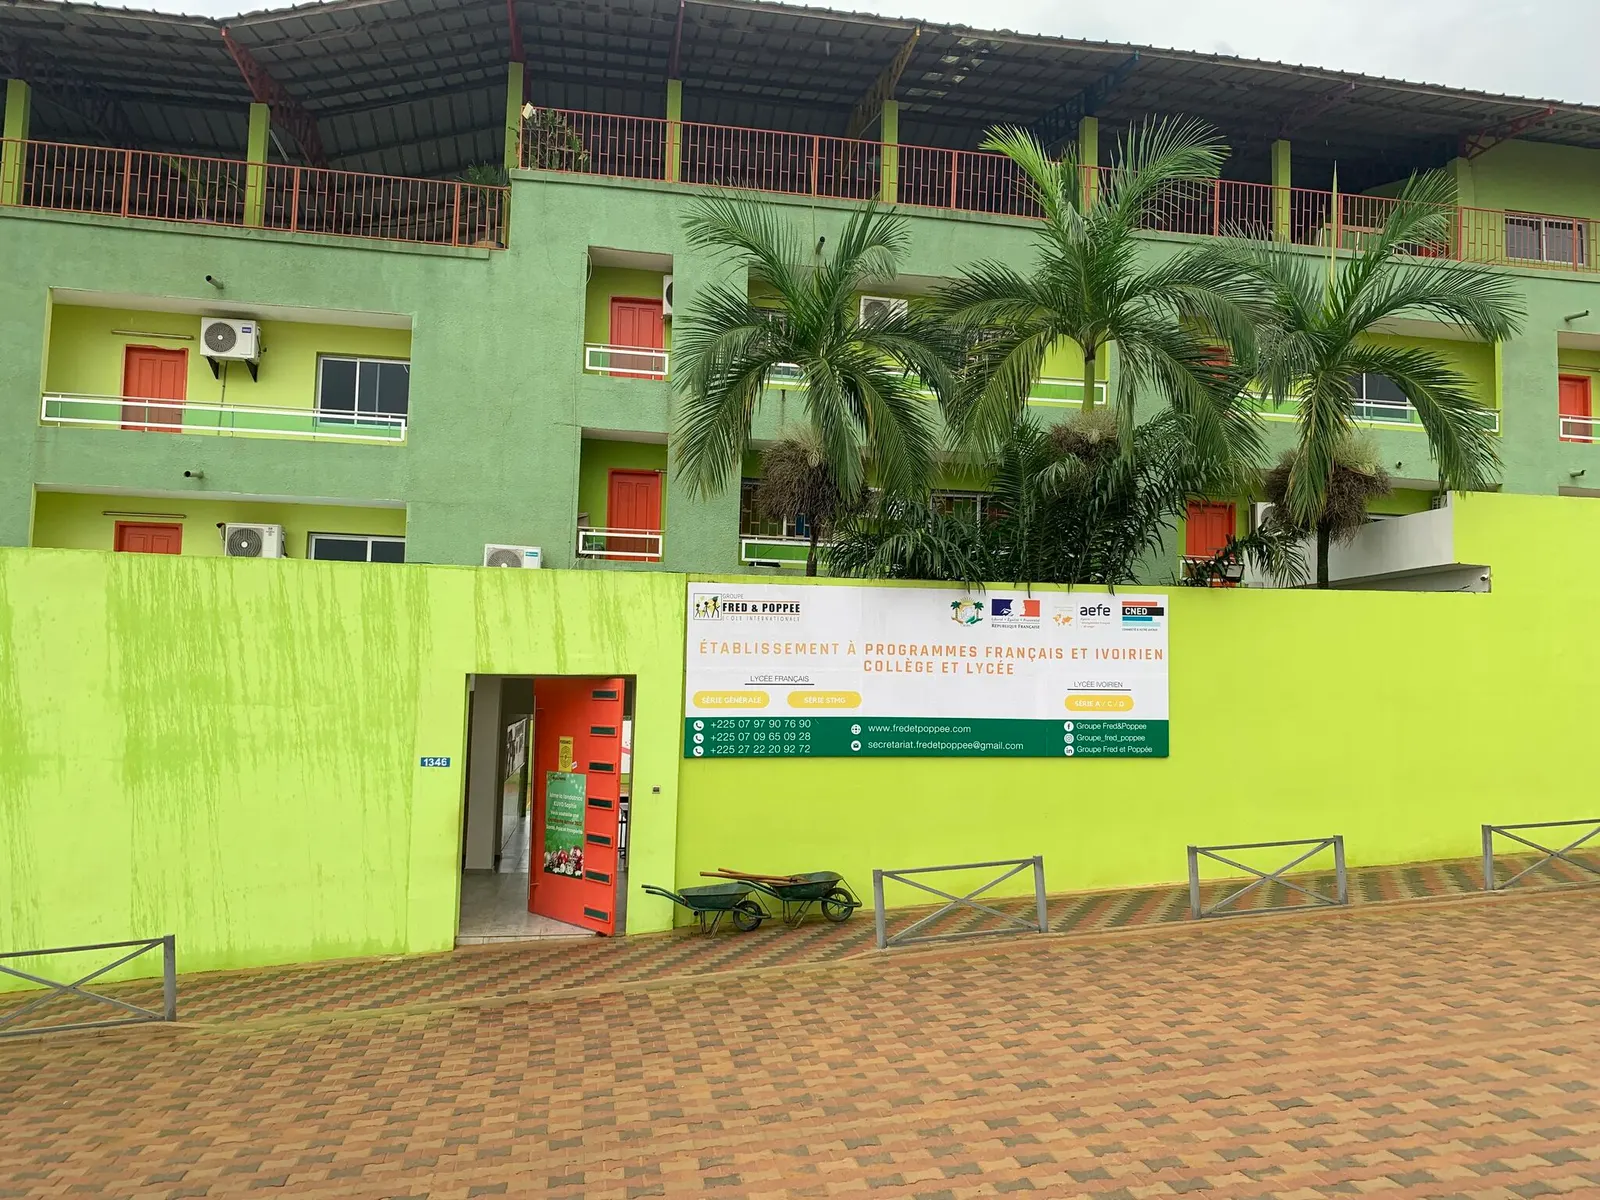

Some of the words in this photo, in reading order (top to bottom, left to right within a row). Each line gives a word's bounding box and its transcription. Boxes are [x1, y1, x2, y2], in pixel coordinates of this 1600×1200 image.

[722, 602, 748, 612] FRED
[751, 603, 758, 613] &
[762, 603, 800, 613] POPPEE
[1080, 603, 1111, 617] aefe
[1125, 608, 1148, 616] CNED
[700, 638, 840, 655] ÉTABLISSEMENT
[847, 640, 857, 655] À
[865, 643, 977, 657] PROGRAMMES
[986, 646, 1064, 662] FRANÇAIS
[1072, 648, 1088, 660] ET
[1096, 648, 1163, 660] IVOIRIEN
[864, 658, 934, 673] COLLÈGE
[942, 661, 958, 673] ET
[966, 660, 1014, 675] LYCÉE
[750, 674, 773, 682] LYCÉE
[774, 675, 810, 683] FRANÇAIS
[1074, 680, 1095, 688] LYCÉE
[702, 695, 722, 704] SÉRIE
[724, 695, 762, 704] GÉNÉRALE
[804, 696, 824, 704] SÉRIE
[1074, 699, 1093, 707] SÉRIE
[710, 720, 736, 728] +225
[738, 720, 750, 728] 07
[753, 720, 766, 728] 97
[768, 720, 781, 728] 90
[784, 720, 796, 728] 76
[798, 720, 812, 728] 90
[1076, 722, 1102, 730] Groupe
[1102, 722, 1146, 730] Fred&Poppee
[868, 724, 971, 734] www.fredetpoppee.com
[710, 732, 736, 742] +225
[738, 732, 750, 742] 07
[753, 732, 766, 742] 09
[768, 732, 781, 742] 65
[784, 732, 796, 742] 09
[798, 732, 812, 742] 28
[1076, 734, 1146, 742] Groupe_fred_poppee
[710, 744, 736, 754] +225
[738, 744, 750, 754] 27
[753, 744, 766, 754] 22
[768, 744, 781, 754] 20
[784, 744, 796, 754] 92
[798, 744, 812, 754] 72
[867, 740, 1024, 752] secretariat.fredetpoppee@gmail.com
[1076, 746, 1102, 754] Groupe
[423, 758, 447, 766] 1346
